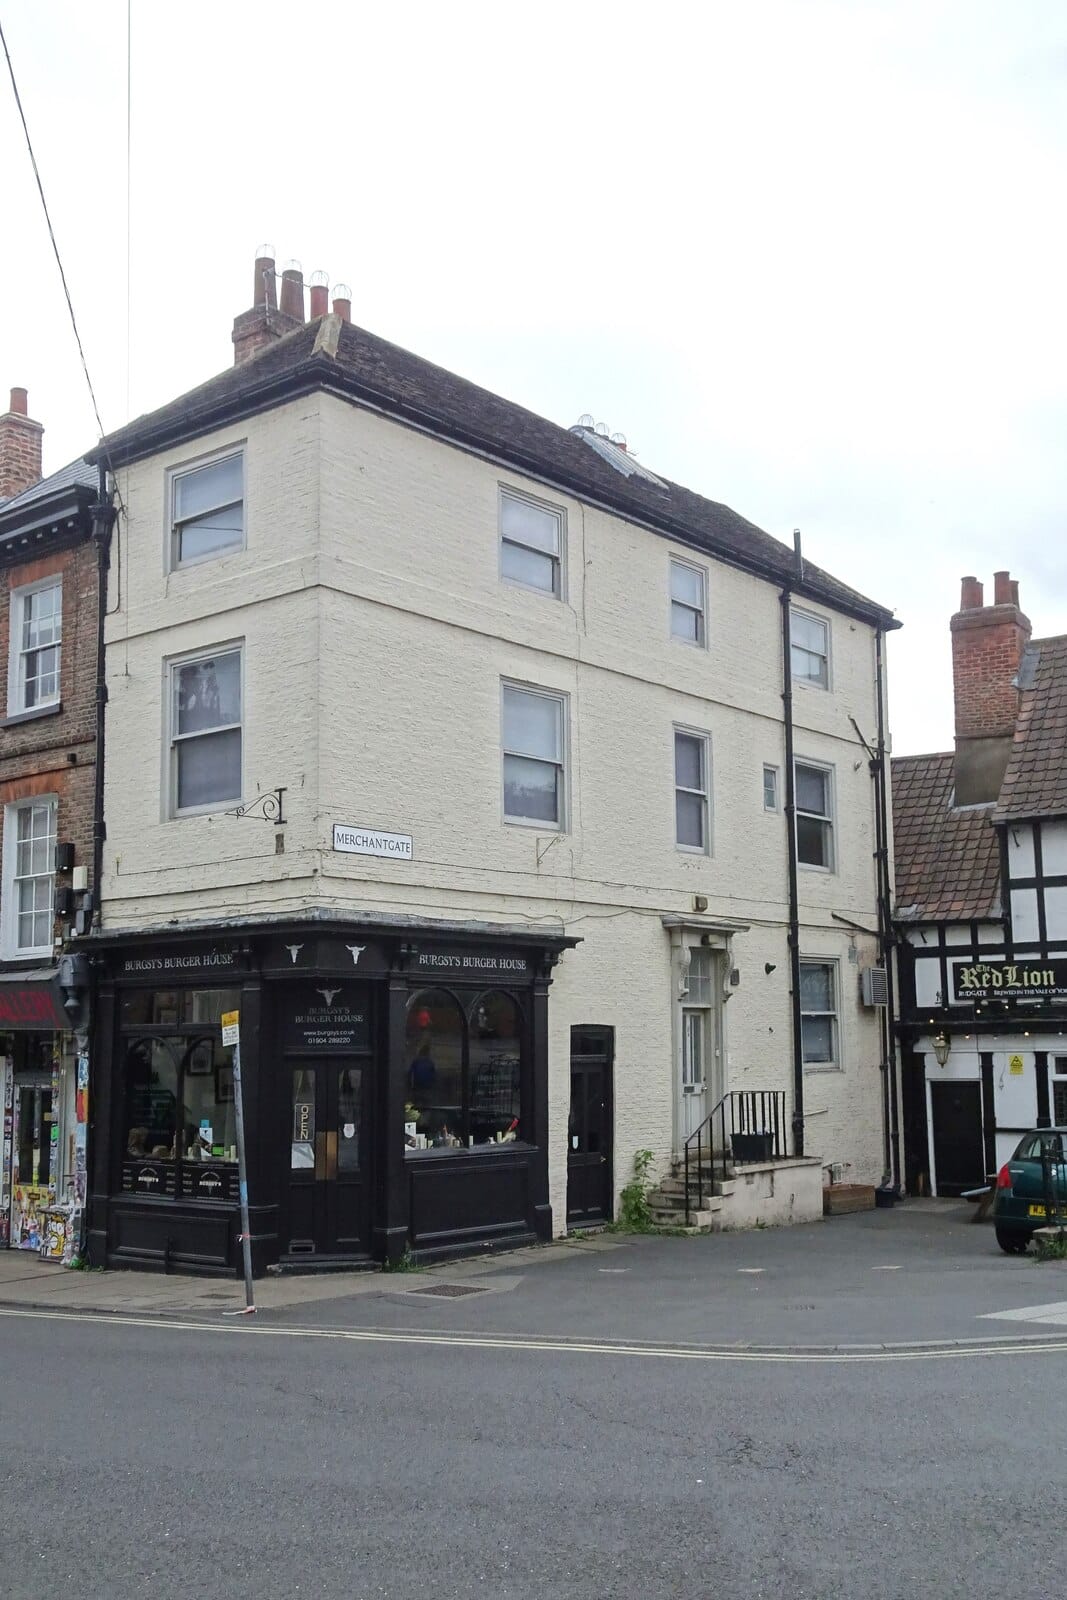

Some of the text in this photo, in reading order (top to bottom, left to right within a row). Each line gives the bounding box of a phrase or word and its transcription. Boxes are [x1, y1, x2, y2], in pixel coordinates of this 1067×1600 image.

[336, 832, 411, 853] MERCHANTGATE
[124, 953, 234, 971] BURGSY'S BURGER HOUSE
[419, 954, 527, 970] BURGSY'S BURGER HOUSE
[959, 965, 1056, 989] Red Lion
[295, 1014, 363, 1023] BURGER HOUSE
[300, 1105, 309, 1141] OPEN
